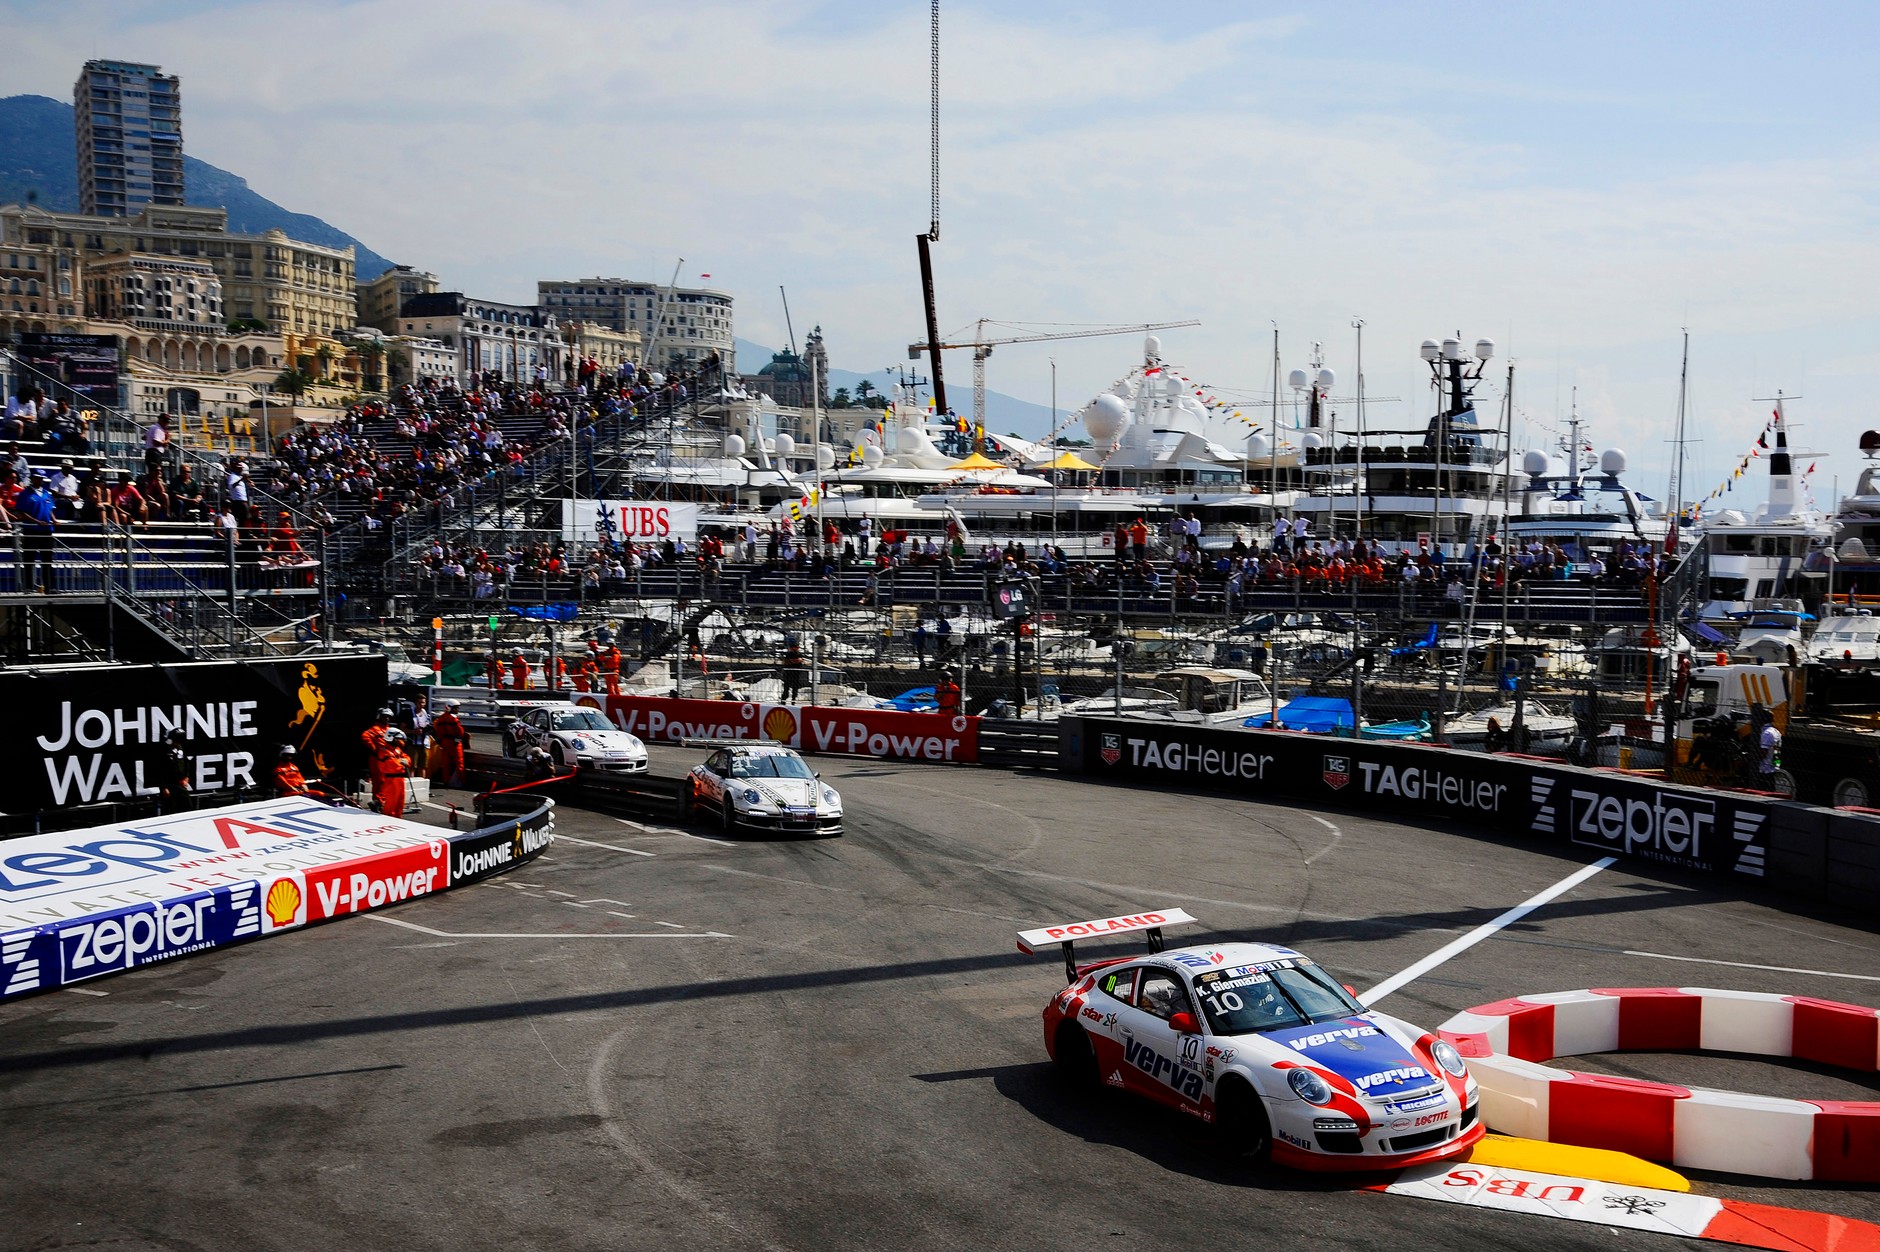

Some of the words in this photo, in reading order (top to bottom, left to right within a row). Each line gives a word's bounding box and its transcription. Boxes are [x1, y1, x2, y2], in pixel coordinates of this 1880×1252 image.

[620, 507, 669, 537] UBS
[36, 700, 258, 752] JOHNNIE
[615, 708, 749, 741] V-Power
[811, 719, 960, 760] V-Power
[732, 760, 753, 768] 41
[1127, 738, 1274, 779] TAGHeuer
[1327, 758, 1346, 772] TAG
[44, 751, 257, 805] WALER
[1358, 761, 1507, 811] TAGHeuer
[1571, 788, 1715, 857] zepter
[168, 824, 408, 869] www.zeptair.com
[452, 841, 513, 880] JOHNNIE
[1639, 849, 1714, 871] INTERNATIONAL
[167, 872, 241, 892] JET
[315, 866, 438, 918] V-Power
[59, 897, 215, 968] zepter
[1046, 913, 1167, 939] POLAND
[141, 940, 217, 964] INTERNATIONAL
[1235, 963, 1272, 974] Mobil
[1106, 975, 1117, 992] 10
[1195, 985, 1211, 997] K.
[1210, 971, 1272, 992] Giermaziak
[1081, 1007, 1104, 1023] star
[1206, 991, 1244, 1016] 10
[1181, 1037, 1198, 1060] 10
[1288, 1025, 1379, 1051] verva
[1206, 1046, 1222, 1057] star
[1124, 1036, 1205, 1103] verva
[1355, 1066, 1425, 1090] verva
[1400, 1095, 1445, 1111] MICHELIN
[1414, 1110, 1449, 1127] LOCTITE
[1278, 1129, 1301, 1147] Mobil
[1442, 1169, 1585, 1205] UBS
